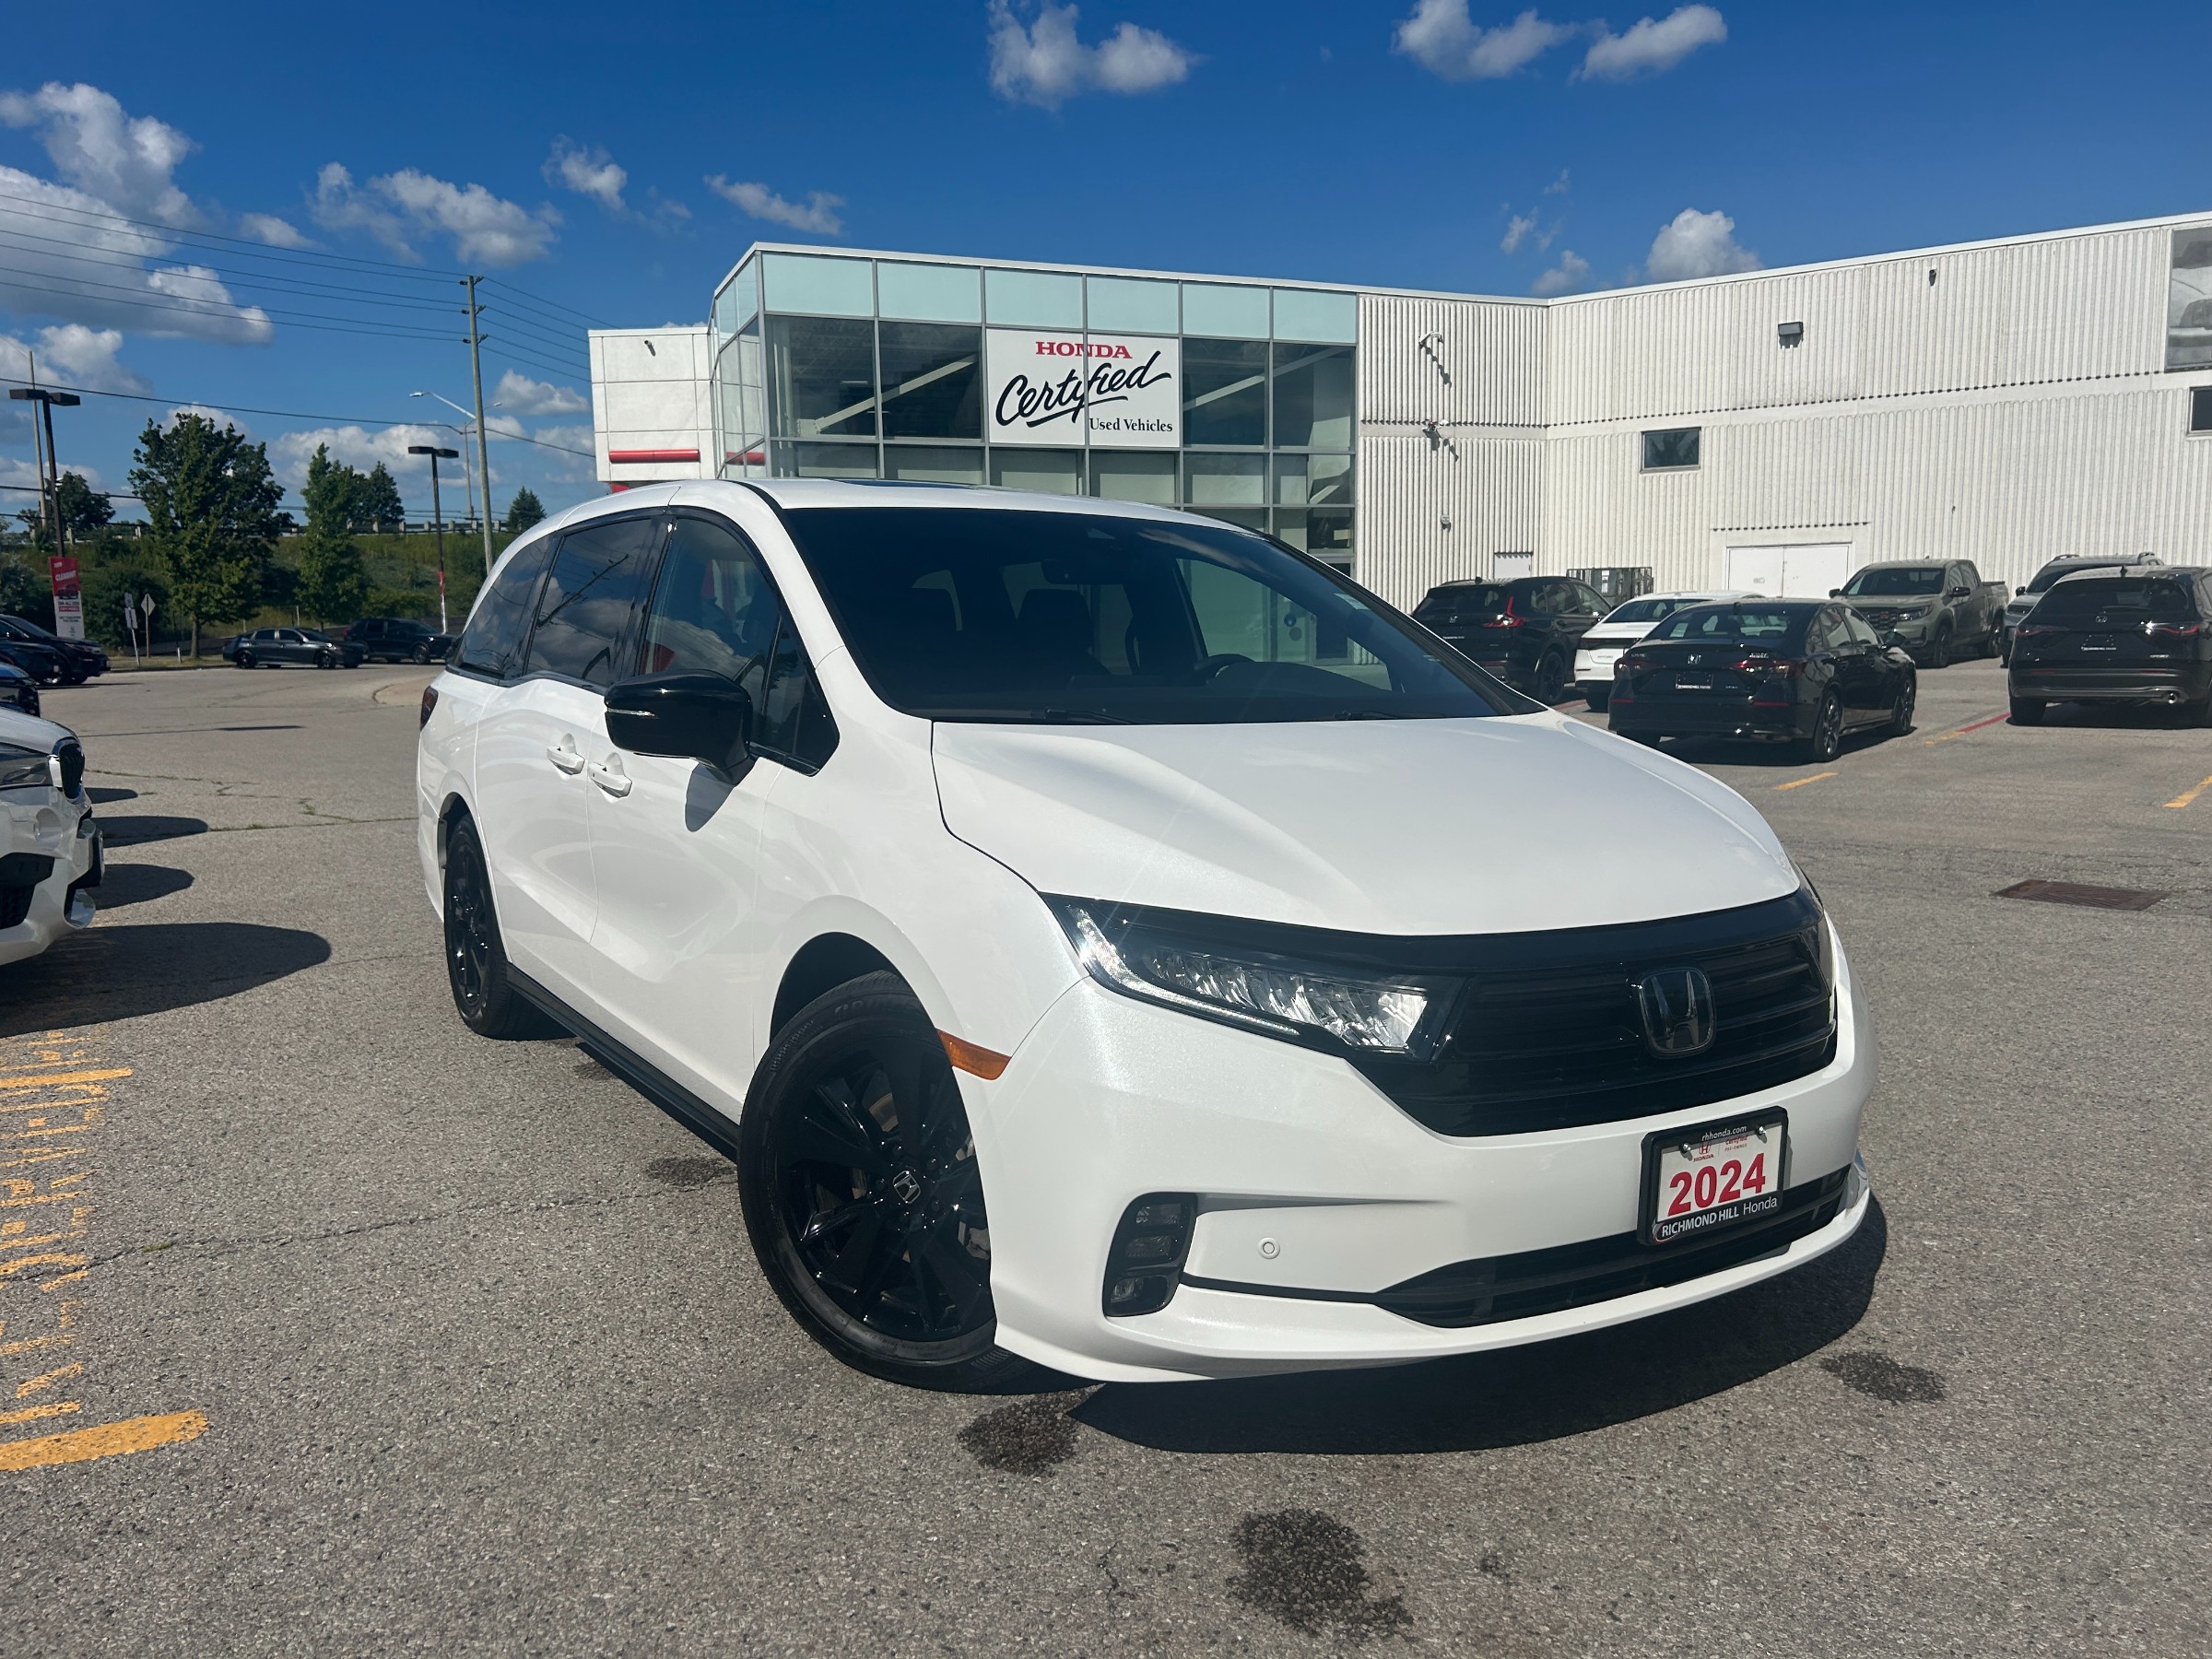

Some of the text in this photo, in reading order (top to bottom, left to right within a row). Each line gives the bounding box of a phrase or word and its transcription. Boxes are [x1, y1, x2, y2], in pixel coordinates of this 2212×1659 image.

[1035, 341, 1133, 359] HONDA
[995, 350, 1172, 428] Certified
[1089, 418, 1173, 432] Used Vehicles
[1701, 1125, 1747, 1142] rhhonda.com
[1693, 1153, 1714, 1162] HONDA
[1667, 1153, 1766, 1217] 2024
[1662, 1196, 1778, 1237] RICHMOND HILL Honda
